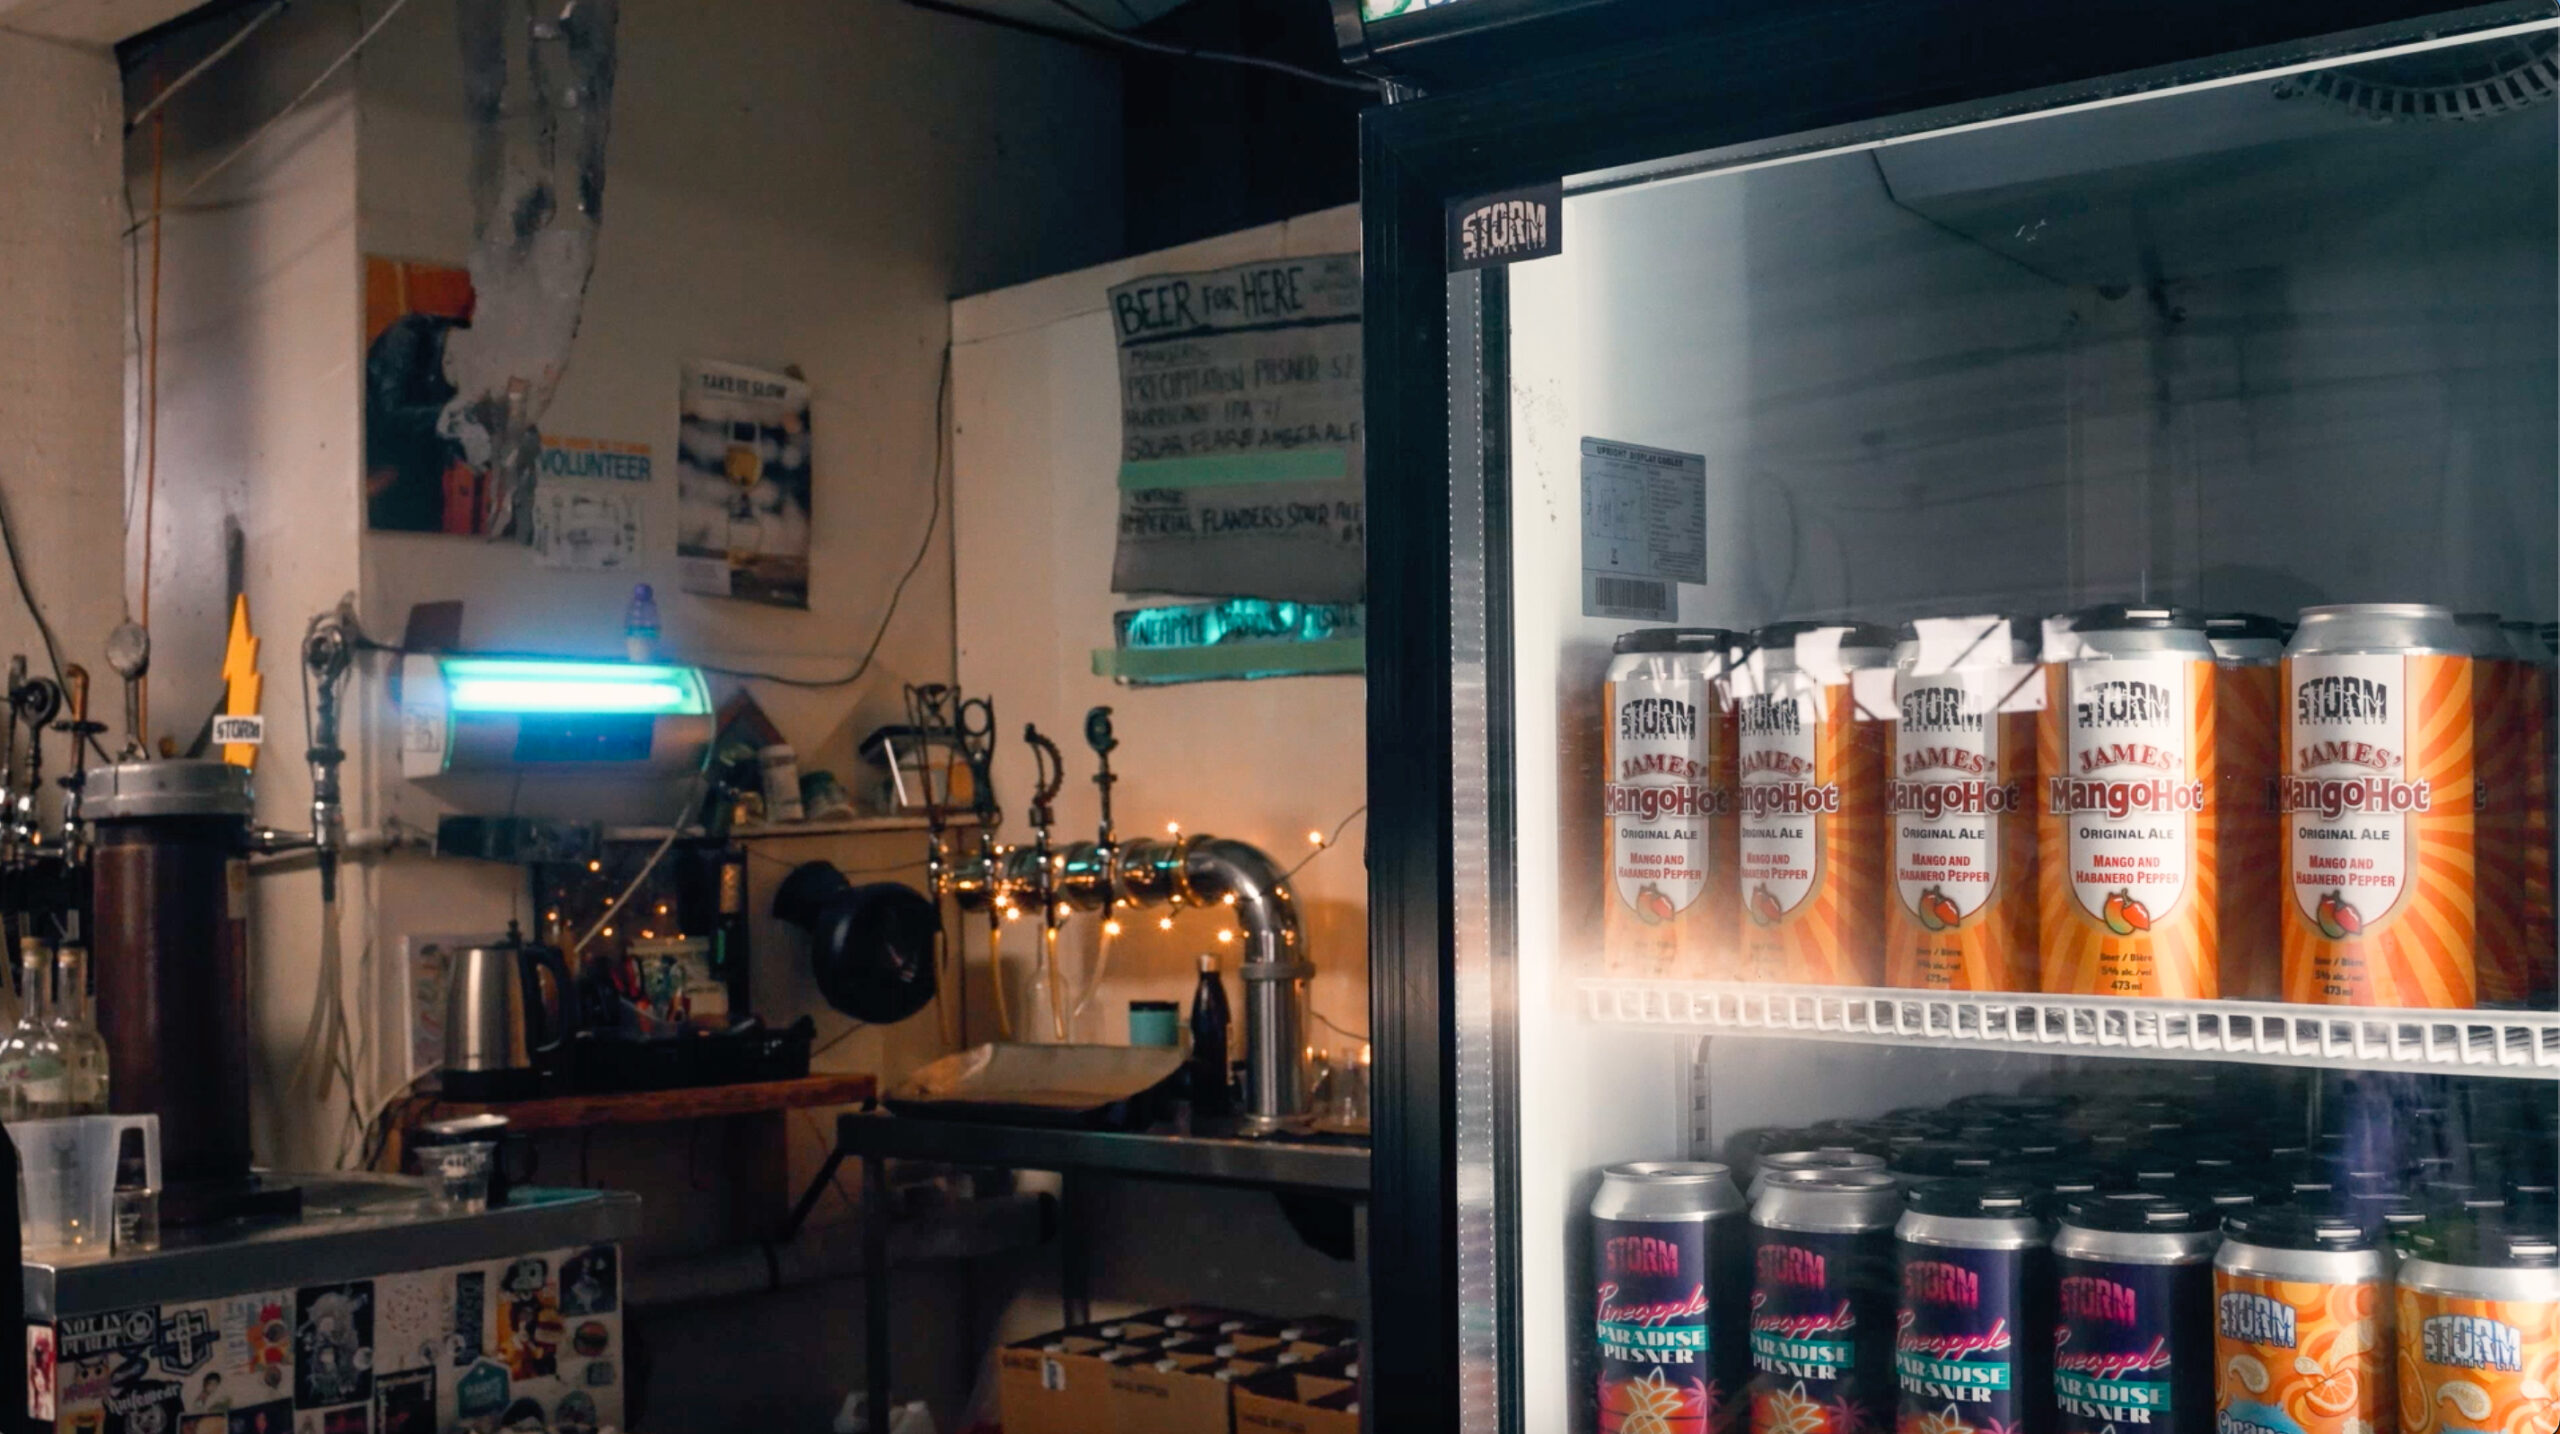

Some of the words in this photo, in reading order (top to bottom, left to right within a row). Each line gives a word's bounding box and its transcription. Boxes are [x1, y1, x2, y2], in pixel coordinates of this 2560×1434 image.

[1463, 200, 1546, 252] STORM
[1116, 280, 1198, 335] BEER
[1241, 266, 1304, 318] HERE
[540, 448, 651, 481] VOLUNTEER
[1202, 506, 1283, 535] FLANDERS
[2298, 676, 2387, 718] STORM
[217, 719, 260, 739] STORM
[1621, 698, 1696, 734] STORM
[2300, 740, 2401, 771] JAMES'
[1605, 783, 1729, 822] MangoHot
[1738, 782, 1839, 822] ngoHot
[1887, 779, 2019, 821] MangoHot
[2049, 777, 2204, 821] MangoHot
[2281, 776, 2431, 821] MangoHot
[1621, 828, 1671, 840] ORIGINAL
[1674, 828, 1697, 840] ALE
[1780, 827, 1803, 839] ALE
[1903, 827, 1956, 839] ORIGINAL
[1957, 828, 1985, 839] ALE
[2080, 828, 2144, 839] ORIGINAL
[2148, 828, 2174, 839] ALE
[2299, 827, 2357, 840] ORIGINAL
[2361, 828, 2390, 840] ALE
[1630, 852, 1662, 865] MANGO
[1664, 855, 1685, 865] AND
[1912, 853, 1946, 866] MANGO
[1948, 856, 1971, 866] AND
[2093, 855, 2135, 867] MANGO
[2138, 857, 2160, 867] AND
[2309, 855, 2347, 869] MANGO
[2350, 858, 2374, 869] AND
[1663, 868, 1702, 880] PEPPER
[1771, 867, 1808, 880] PEPPER
[1948, 869, 1990, 882] PEPPER
[2076, 871, 2134, 884] HABANERO
[2137, 871, 2179, 884] PEPPER
[2295, 872, 2346, 886] HABANERO
[2349, 873, 2395, 887] PEPPER
[2111, 980, 2130, 990] 473
[1606, 1236, 1679, 1278] STORM
[1756, 1244, 1825, 1290] STORM
[1904, 1262, 1978, 1310] STORM
[1597, 1282, 1709, 1329] Pineapple
[1750, 1291, 1856, 1340] Pineapple
[2060, 1277, 2136, 1327] STORM
[61, 1317, 97, 1336] NOT
[103, 1313, 121, 1328] IN
[2219, 1292, 2296, 1342] STORM
[1597, 1322, 1706, 1347] PARADISE
[1751, 1334, 1847, 1363] PARADISE
[1896, 1309, 2011, 1361] Pineapple
[2424, 1316, 2521, 1364] STORM
[1604, 1344, 1694, 1364] PILSNER
[1753, 1354, 1837, 1380] PILSNER
[2053, 1326, 2171, 1380] Pineapple
[1896, 1355, 2007, 1385] PARADISE
[1900, 1376, 1992, 1403] PILSNER
[2054, 1372, 2162, 1406] PARADISE
[2057, 1395, 2151, 1424] PILSNER
